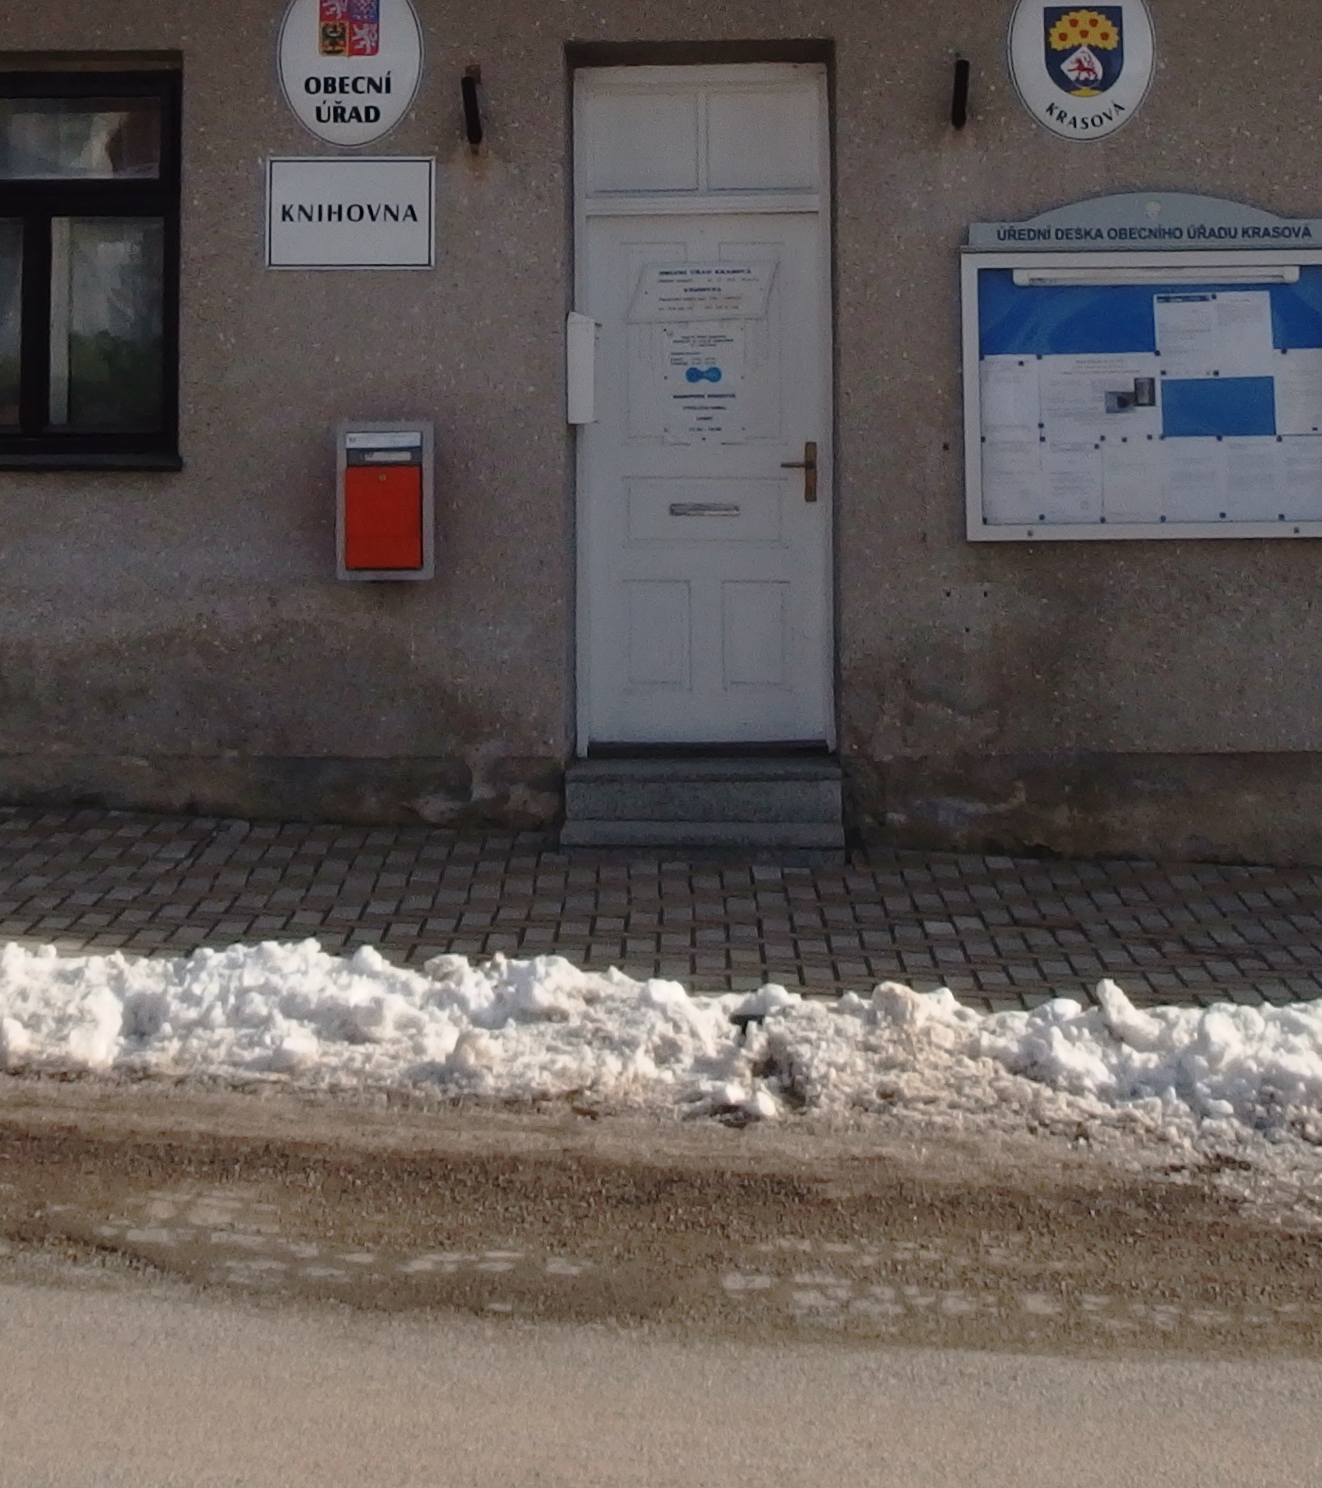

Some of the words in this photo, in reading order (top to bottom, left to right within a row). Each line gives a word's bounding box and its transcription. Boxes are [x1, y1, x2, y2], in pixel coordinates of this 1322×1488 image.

[304, 70, 392, 95] OBECNÍ
[315, 99, 381, 124] ÚŘAD
[1045, 100, 1125, 130] KRASOVÁ
[280, 203, 418, 223] KNIHOVNA
[996, 225, 1052, 242] ÚŘEDNÍ
[1054, 227, 1104, 241] DESKA
[1107, 224, 1184, 240] OBECNÍHO
[1186, 223, 1239, 240] ÚŘADU
[1241, 223, 1313, 239] KRASOVÁ
